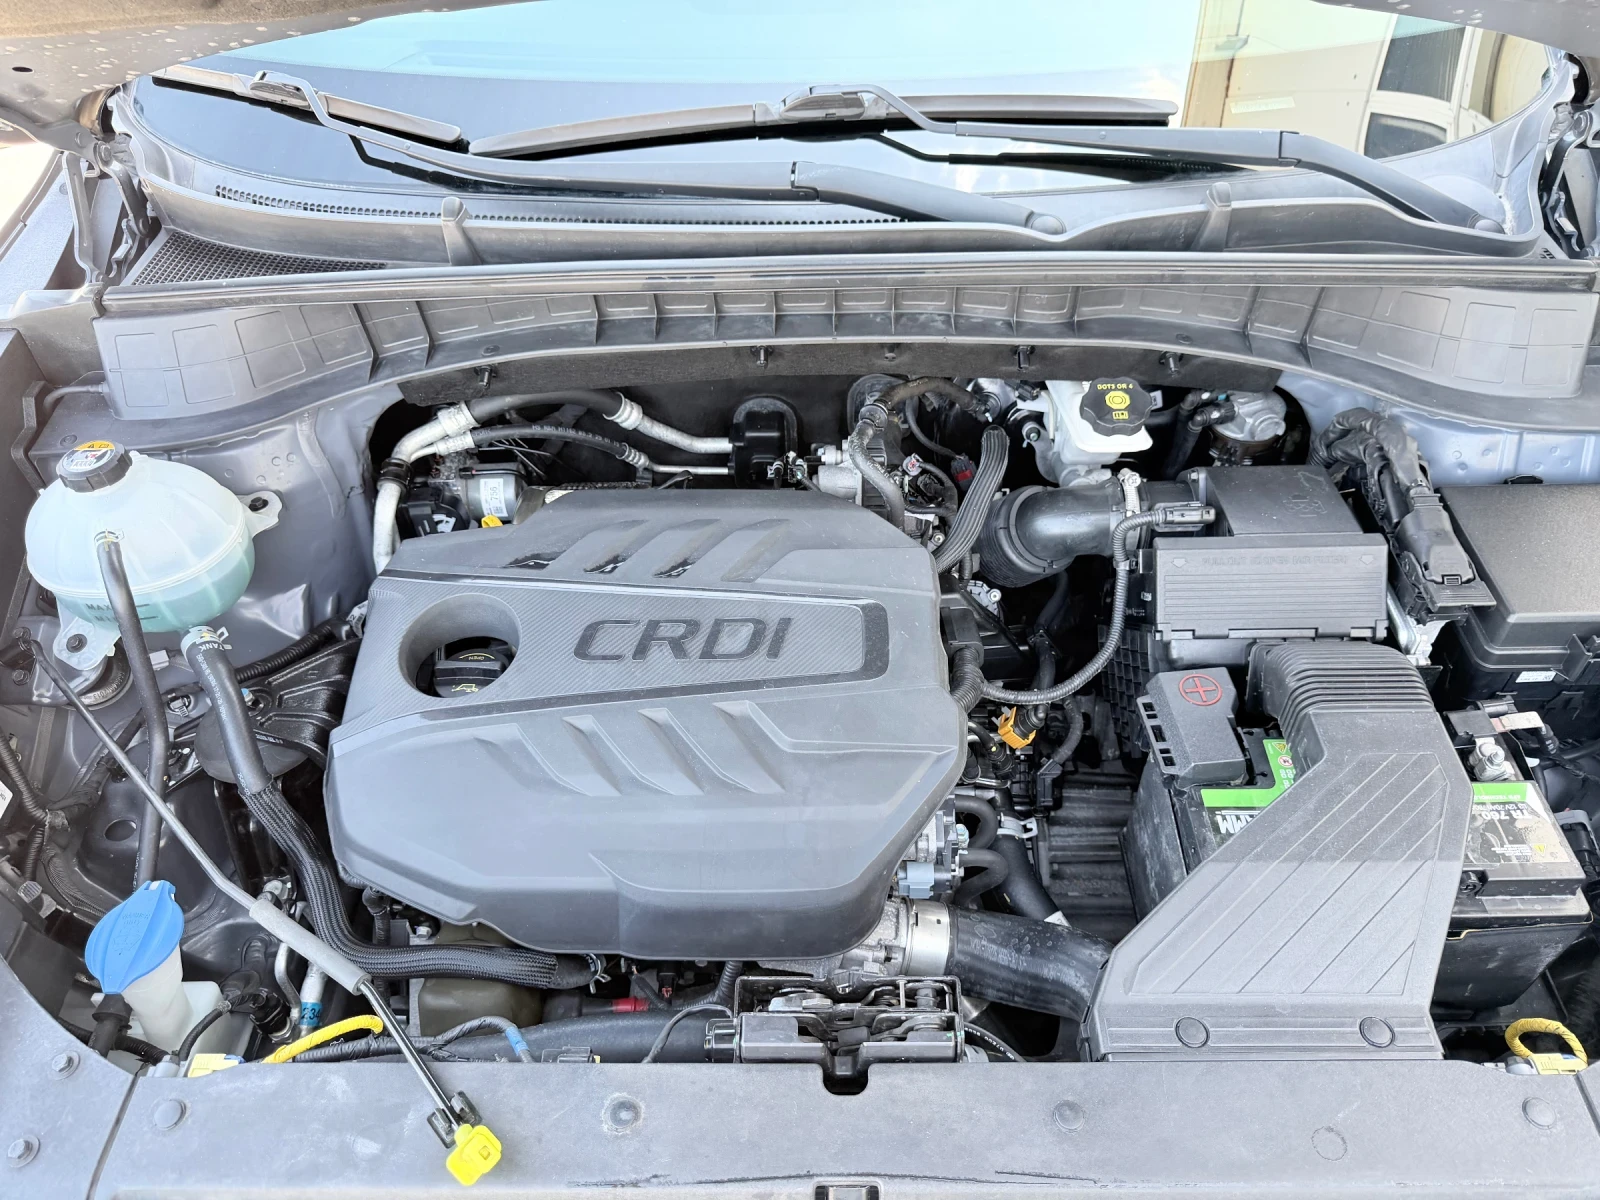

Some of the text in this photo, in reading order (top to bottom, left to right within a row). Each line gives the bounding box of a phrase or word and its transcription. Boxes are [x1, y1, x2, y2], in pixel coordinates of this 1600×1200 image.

[85, 603, 112, 611] MAX
[573, 617, 794, 662] CRDI
[198, 641, 225, 653] TANK
[1481, 809, 1532, 820] TR 760
